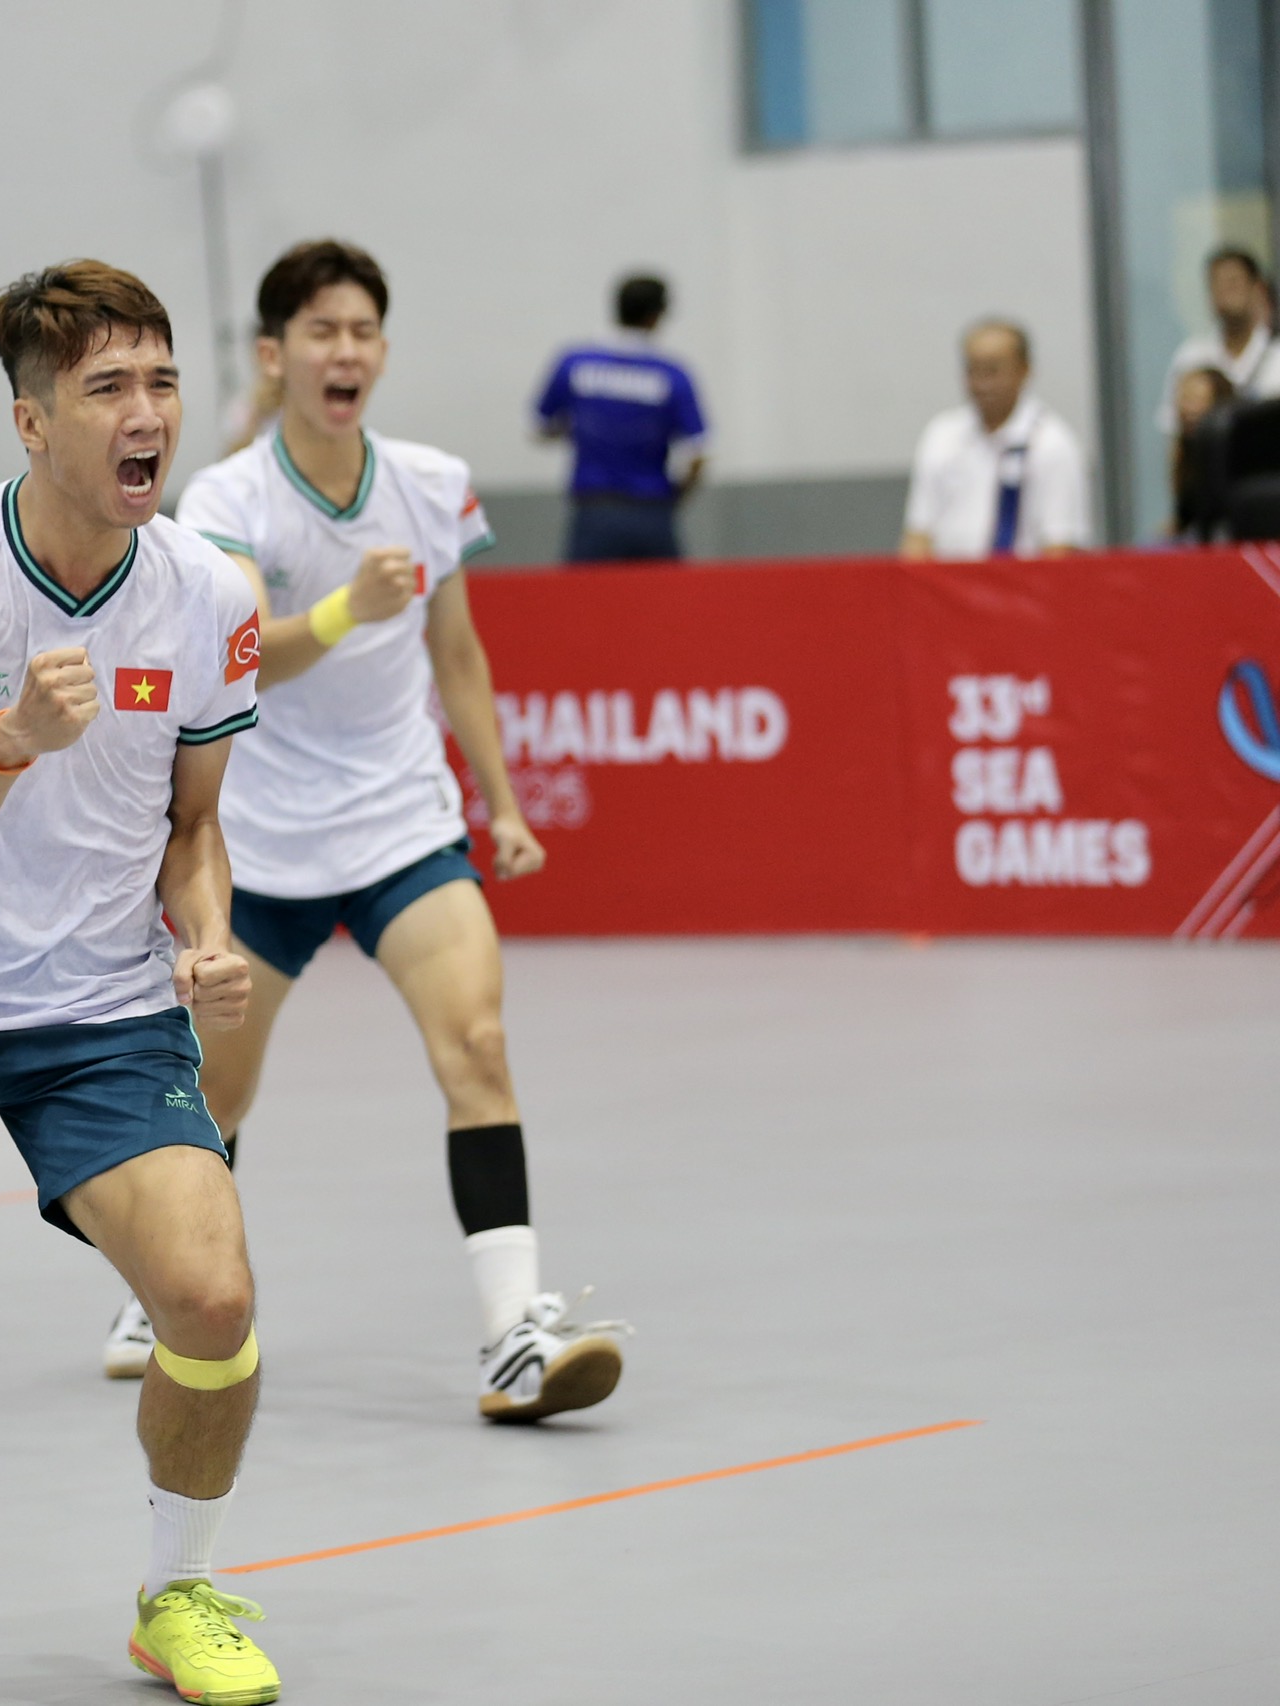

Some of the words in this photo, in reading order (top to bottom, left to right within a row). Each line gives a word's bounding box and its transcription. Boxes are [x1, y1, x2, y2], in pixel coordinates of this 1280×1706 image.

[493, 687, 788, 763] HAILAND
[950, 746, 1063, 814] SEA
[954, 818, 1152, 887] GAMES
[165, 1097, 199, 1114] MIRA
